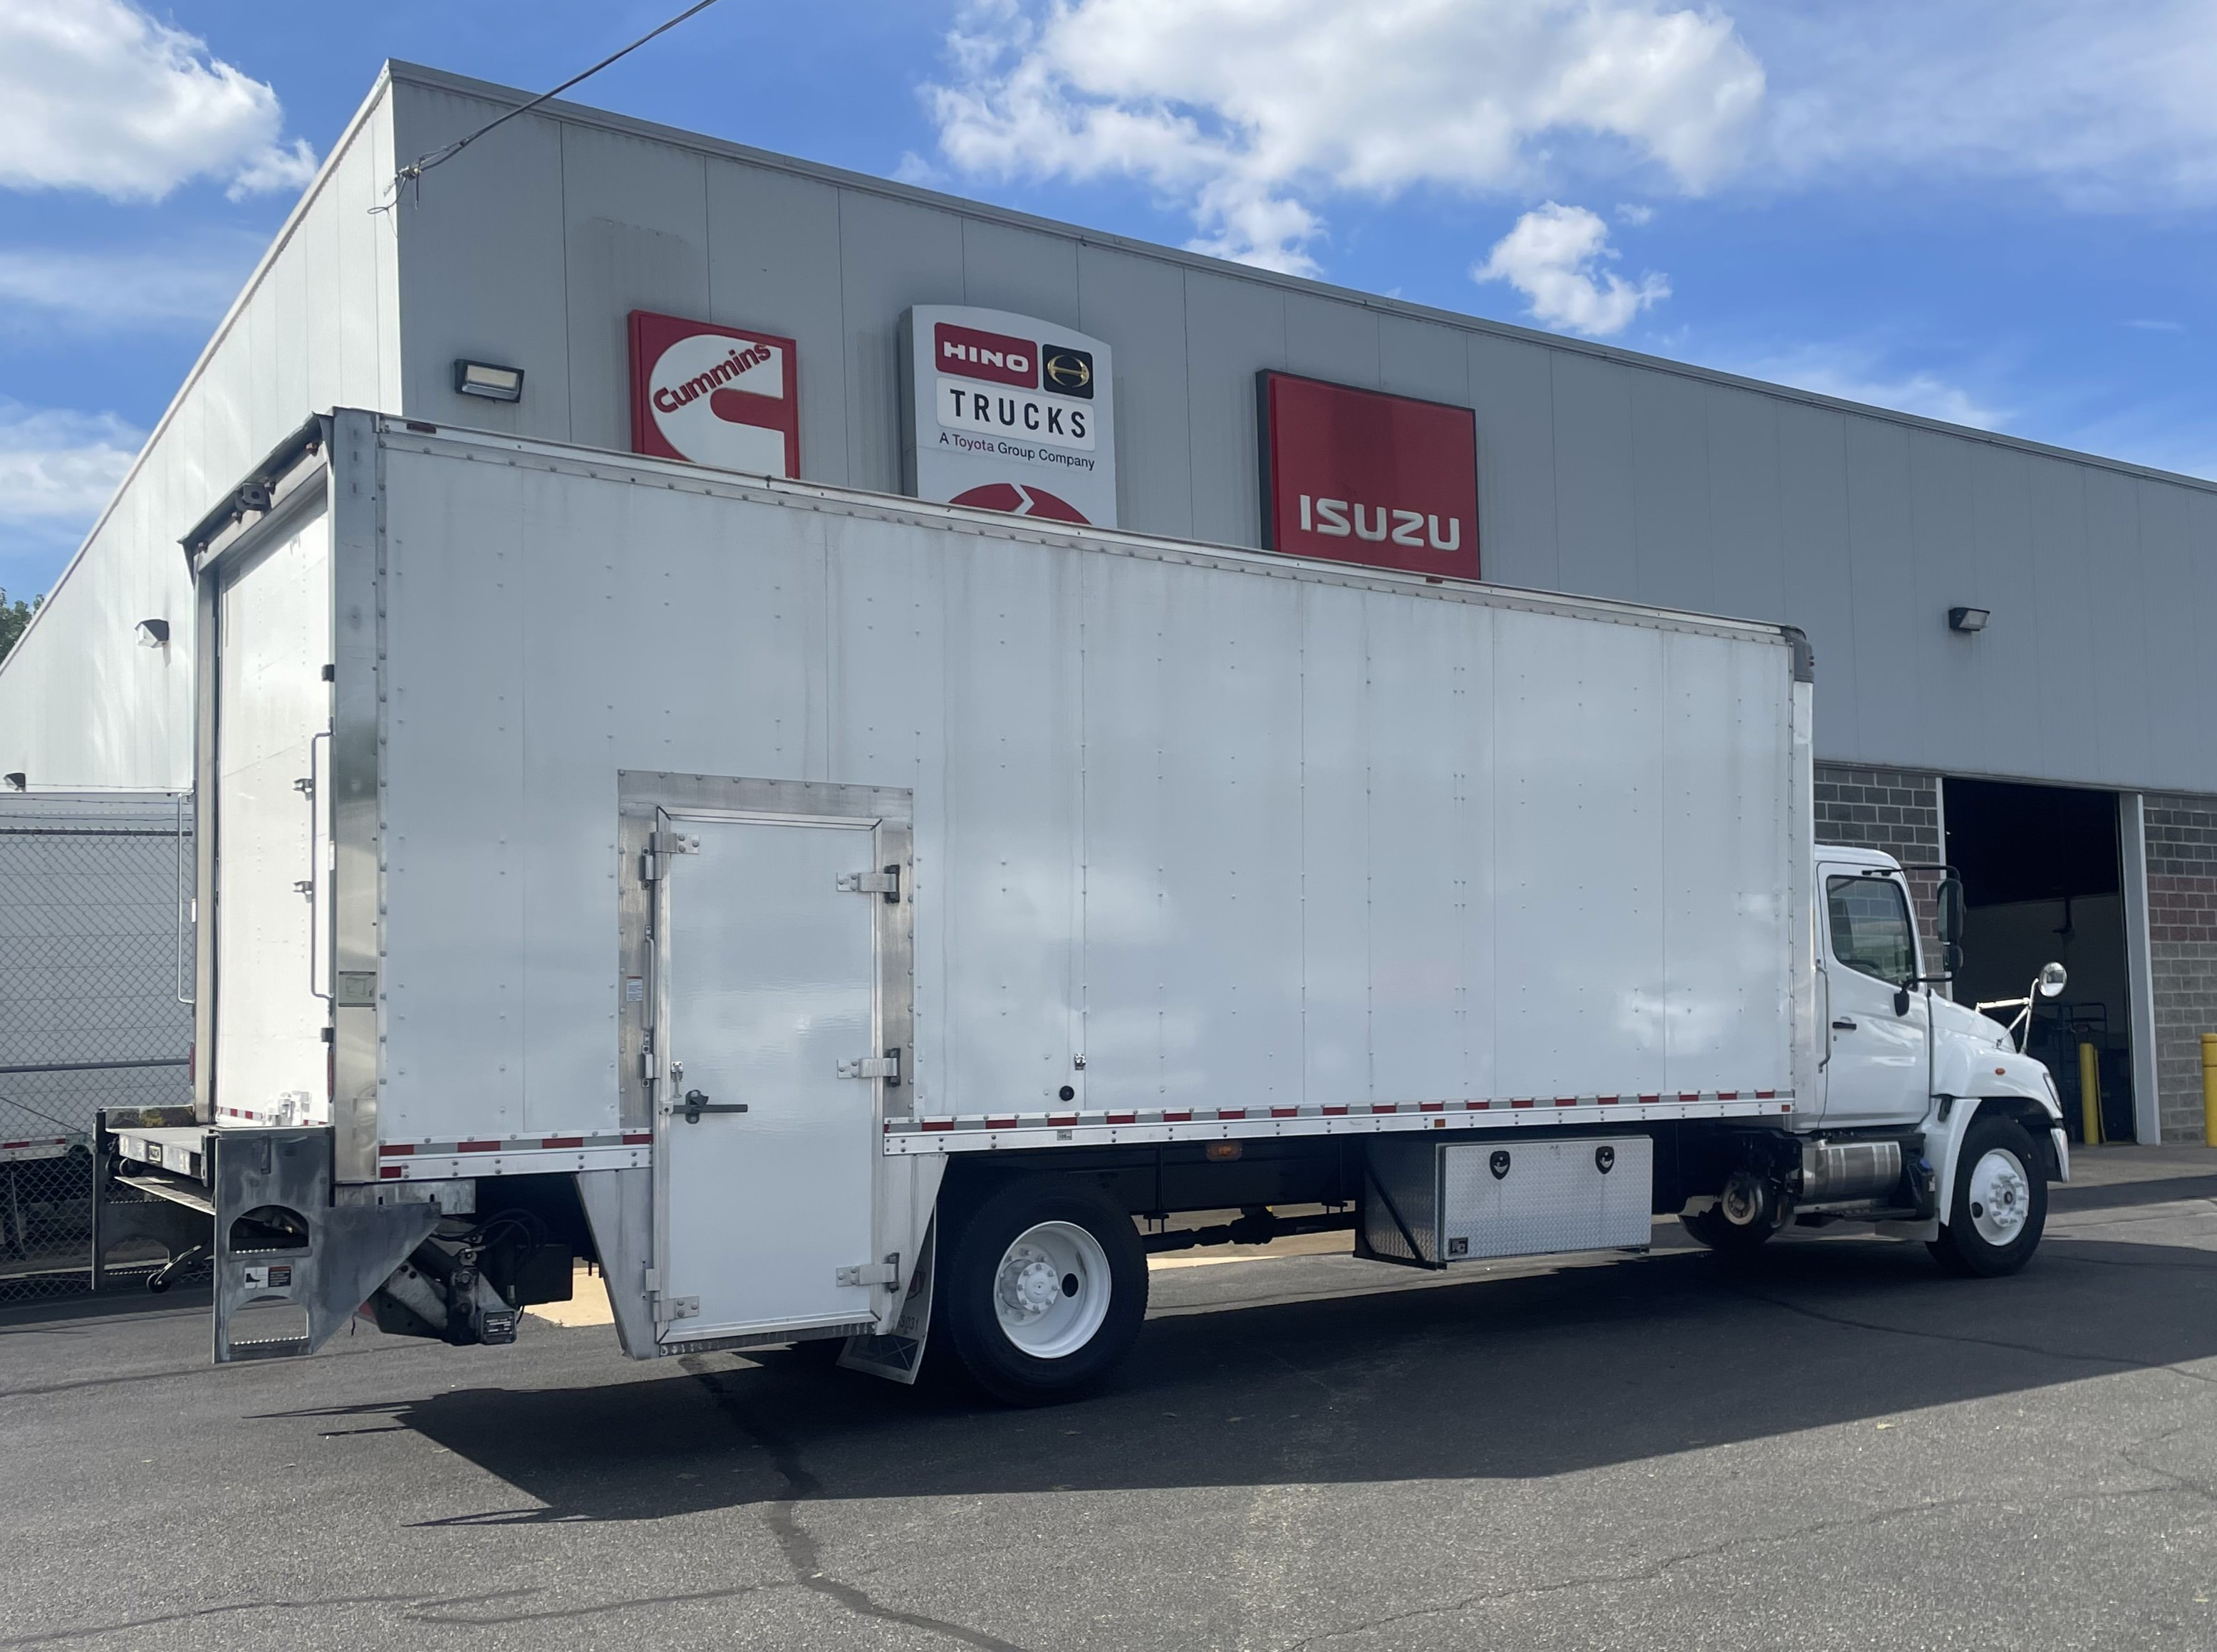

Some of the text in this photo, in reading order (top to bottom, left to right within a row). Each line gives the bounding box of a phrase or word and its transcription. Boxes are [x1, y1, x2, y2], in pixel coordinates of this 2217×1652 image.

[653, 343, 771, 413] Cummins
[943, 341, 1029, 373] HINO
[950, 388, 1086, 439] TRUCKS
[939, 432, 1095, 472] A Toyota Group Company
[1299, 494, 1460, 551] ISUZU
